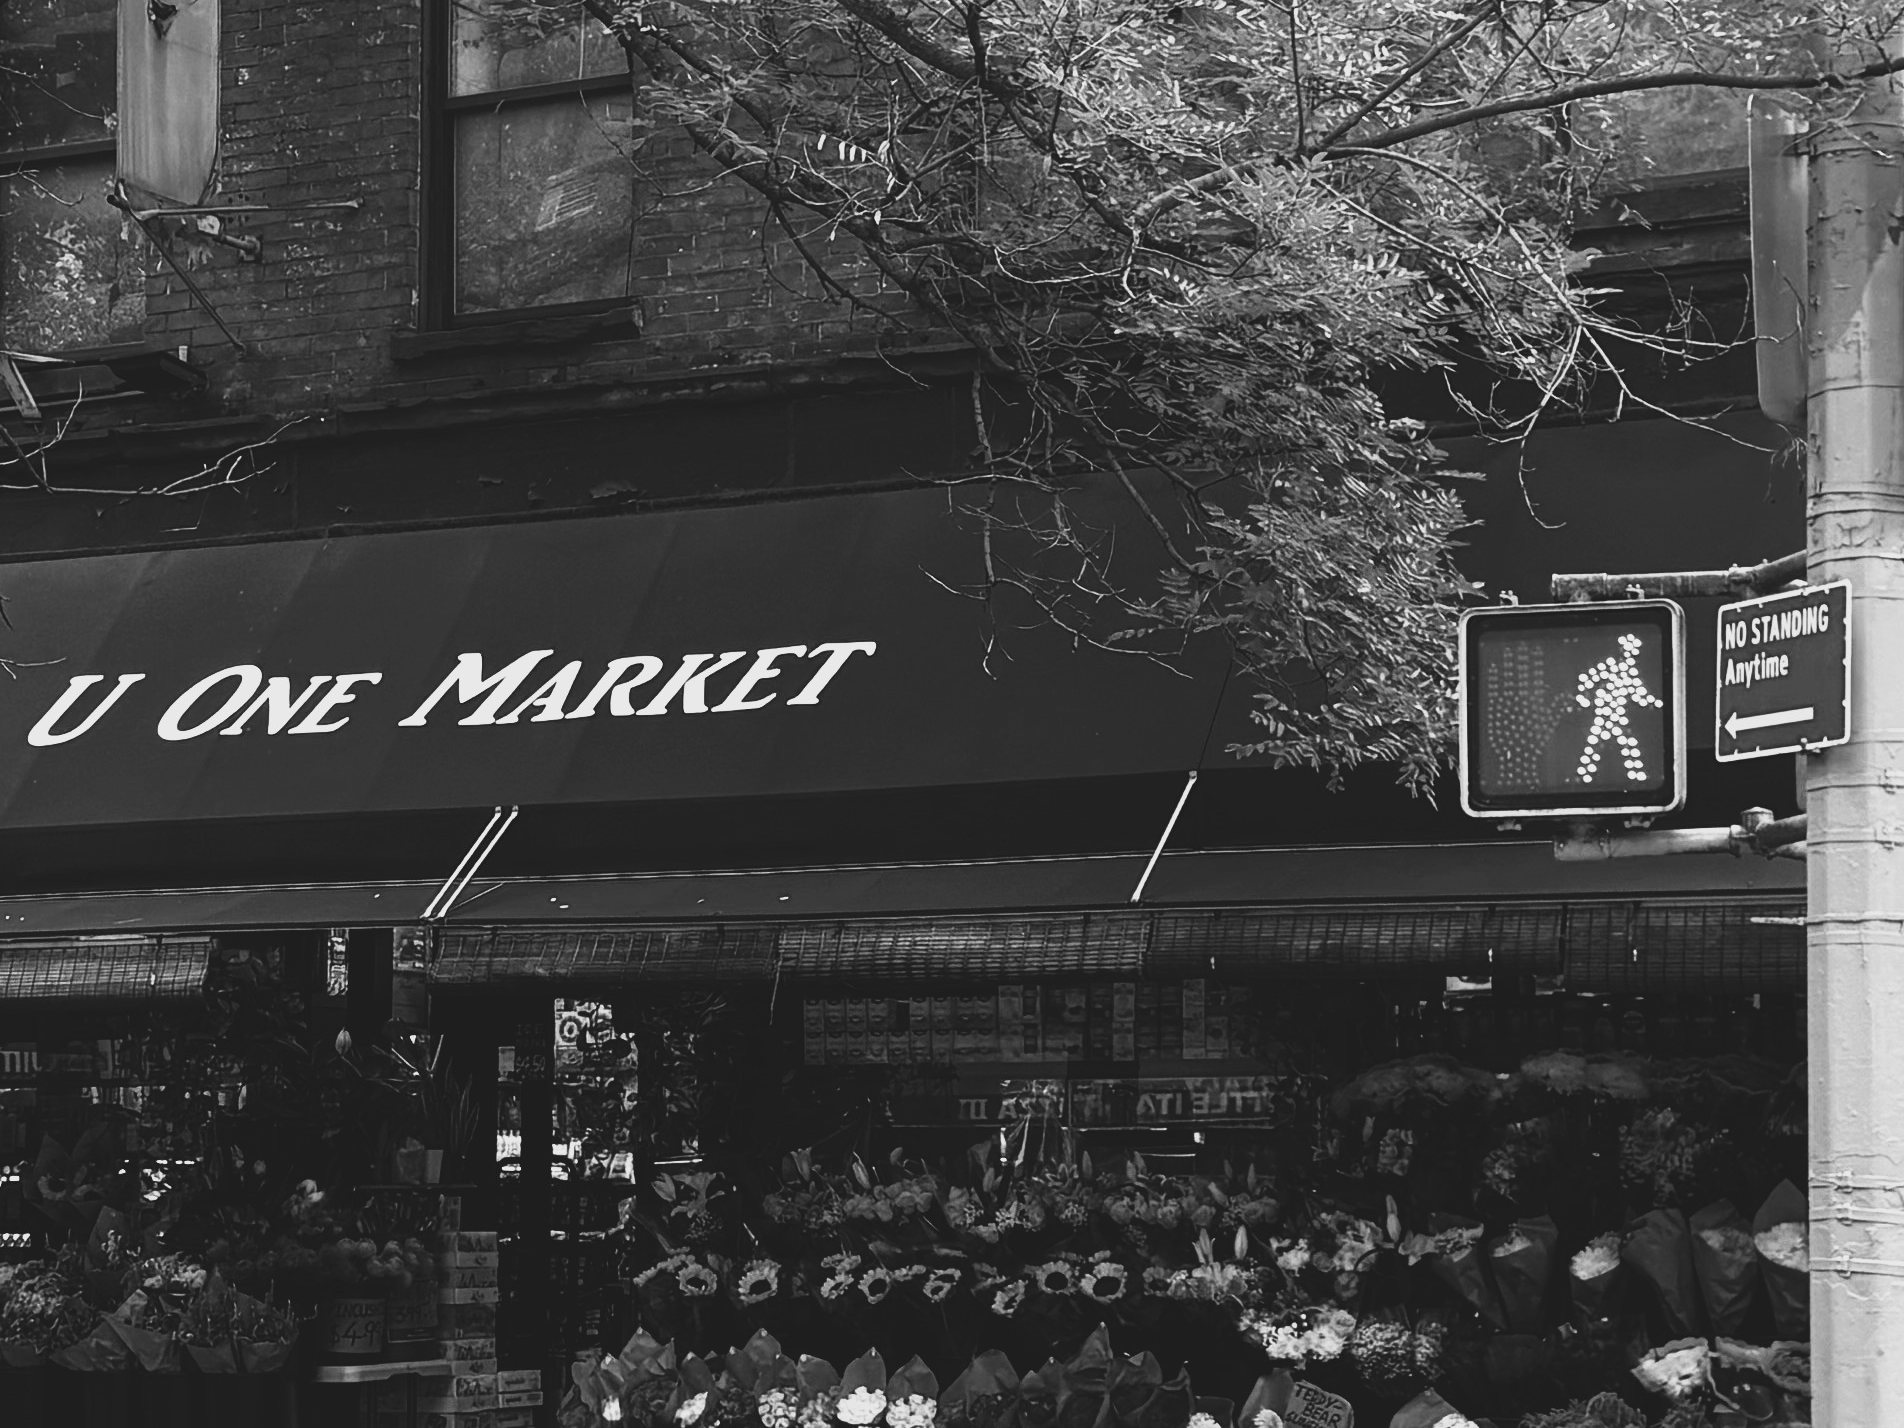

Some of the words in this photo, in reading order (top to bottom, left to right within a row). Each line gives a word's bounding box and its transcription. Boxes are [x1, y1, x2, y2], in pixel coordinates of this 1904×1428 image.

[1725, 620, 1747, 650] NO
[1751, 603, 1829, 645] STANDING
[27, 673, 147, 746] U
[157, 664, 382, 741] ONE
[398, 641, 877, 727] MARKET
[1725, 652, 1789, 689] Anytime
